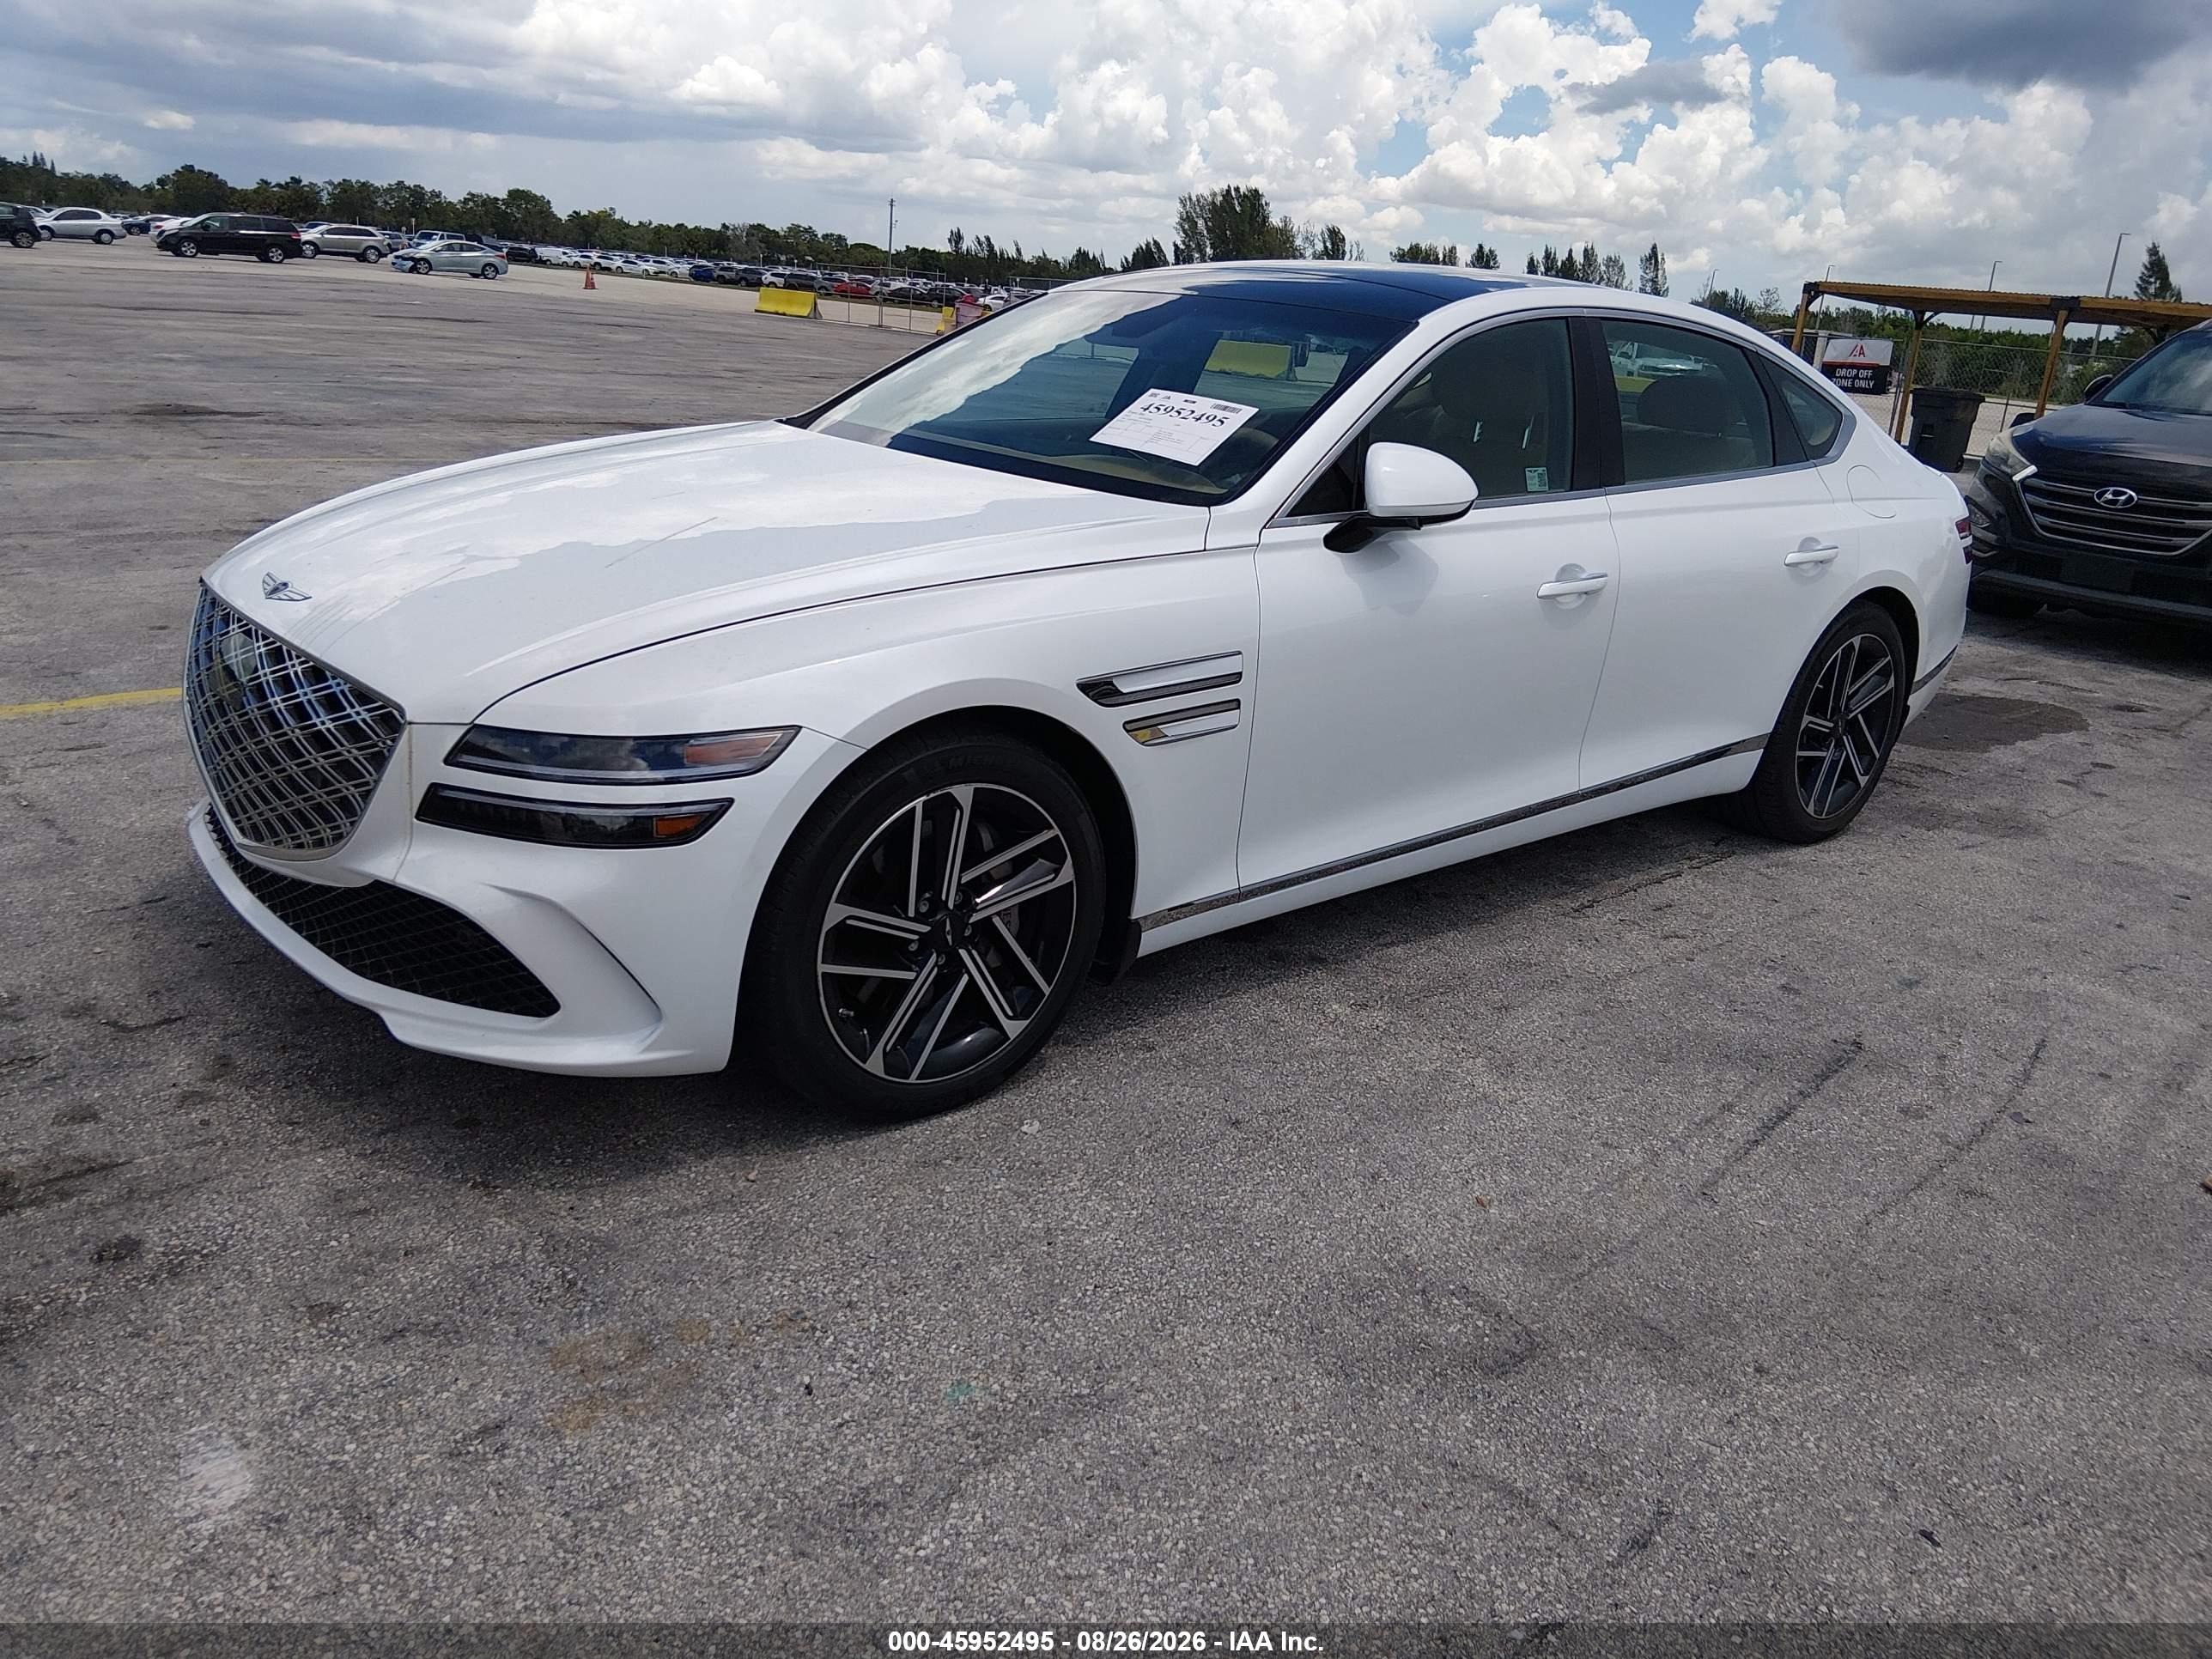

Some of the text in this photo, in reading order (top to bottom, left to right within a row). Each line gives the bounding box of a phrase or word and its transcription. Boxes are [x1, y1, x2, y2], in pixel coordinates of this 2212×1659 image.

[1835, 368, 1873, 379] DROP OFF
[1854, 379, 1875, 389] ONLY
[1139, 402, 1231, 428] 45952495
